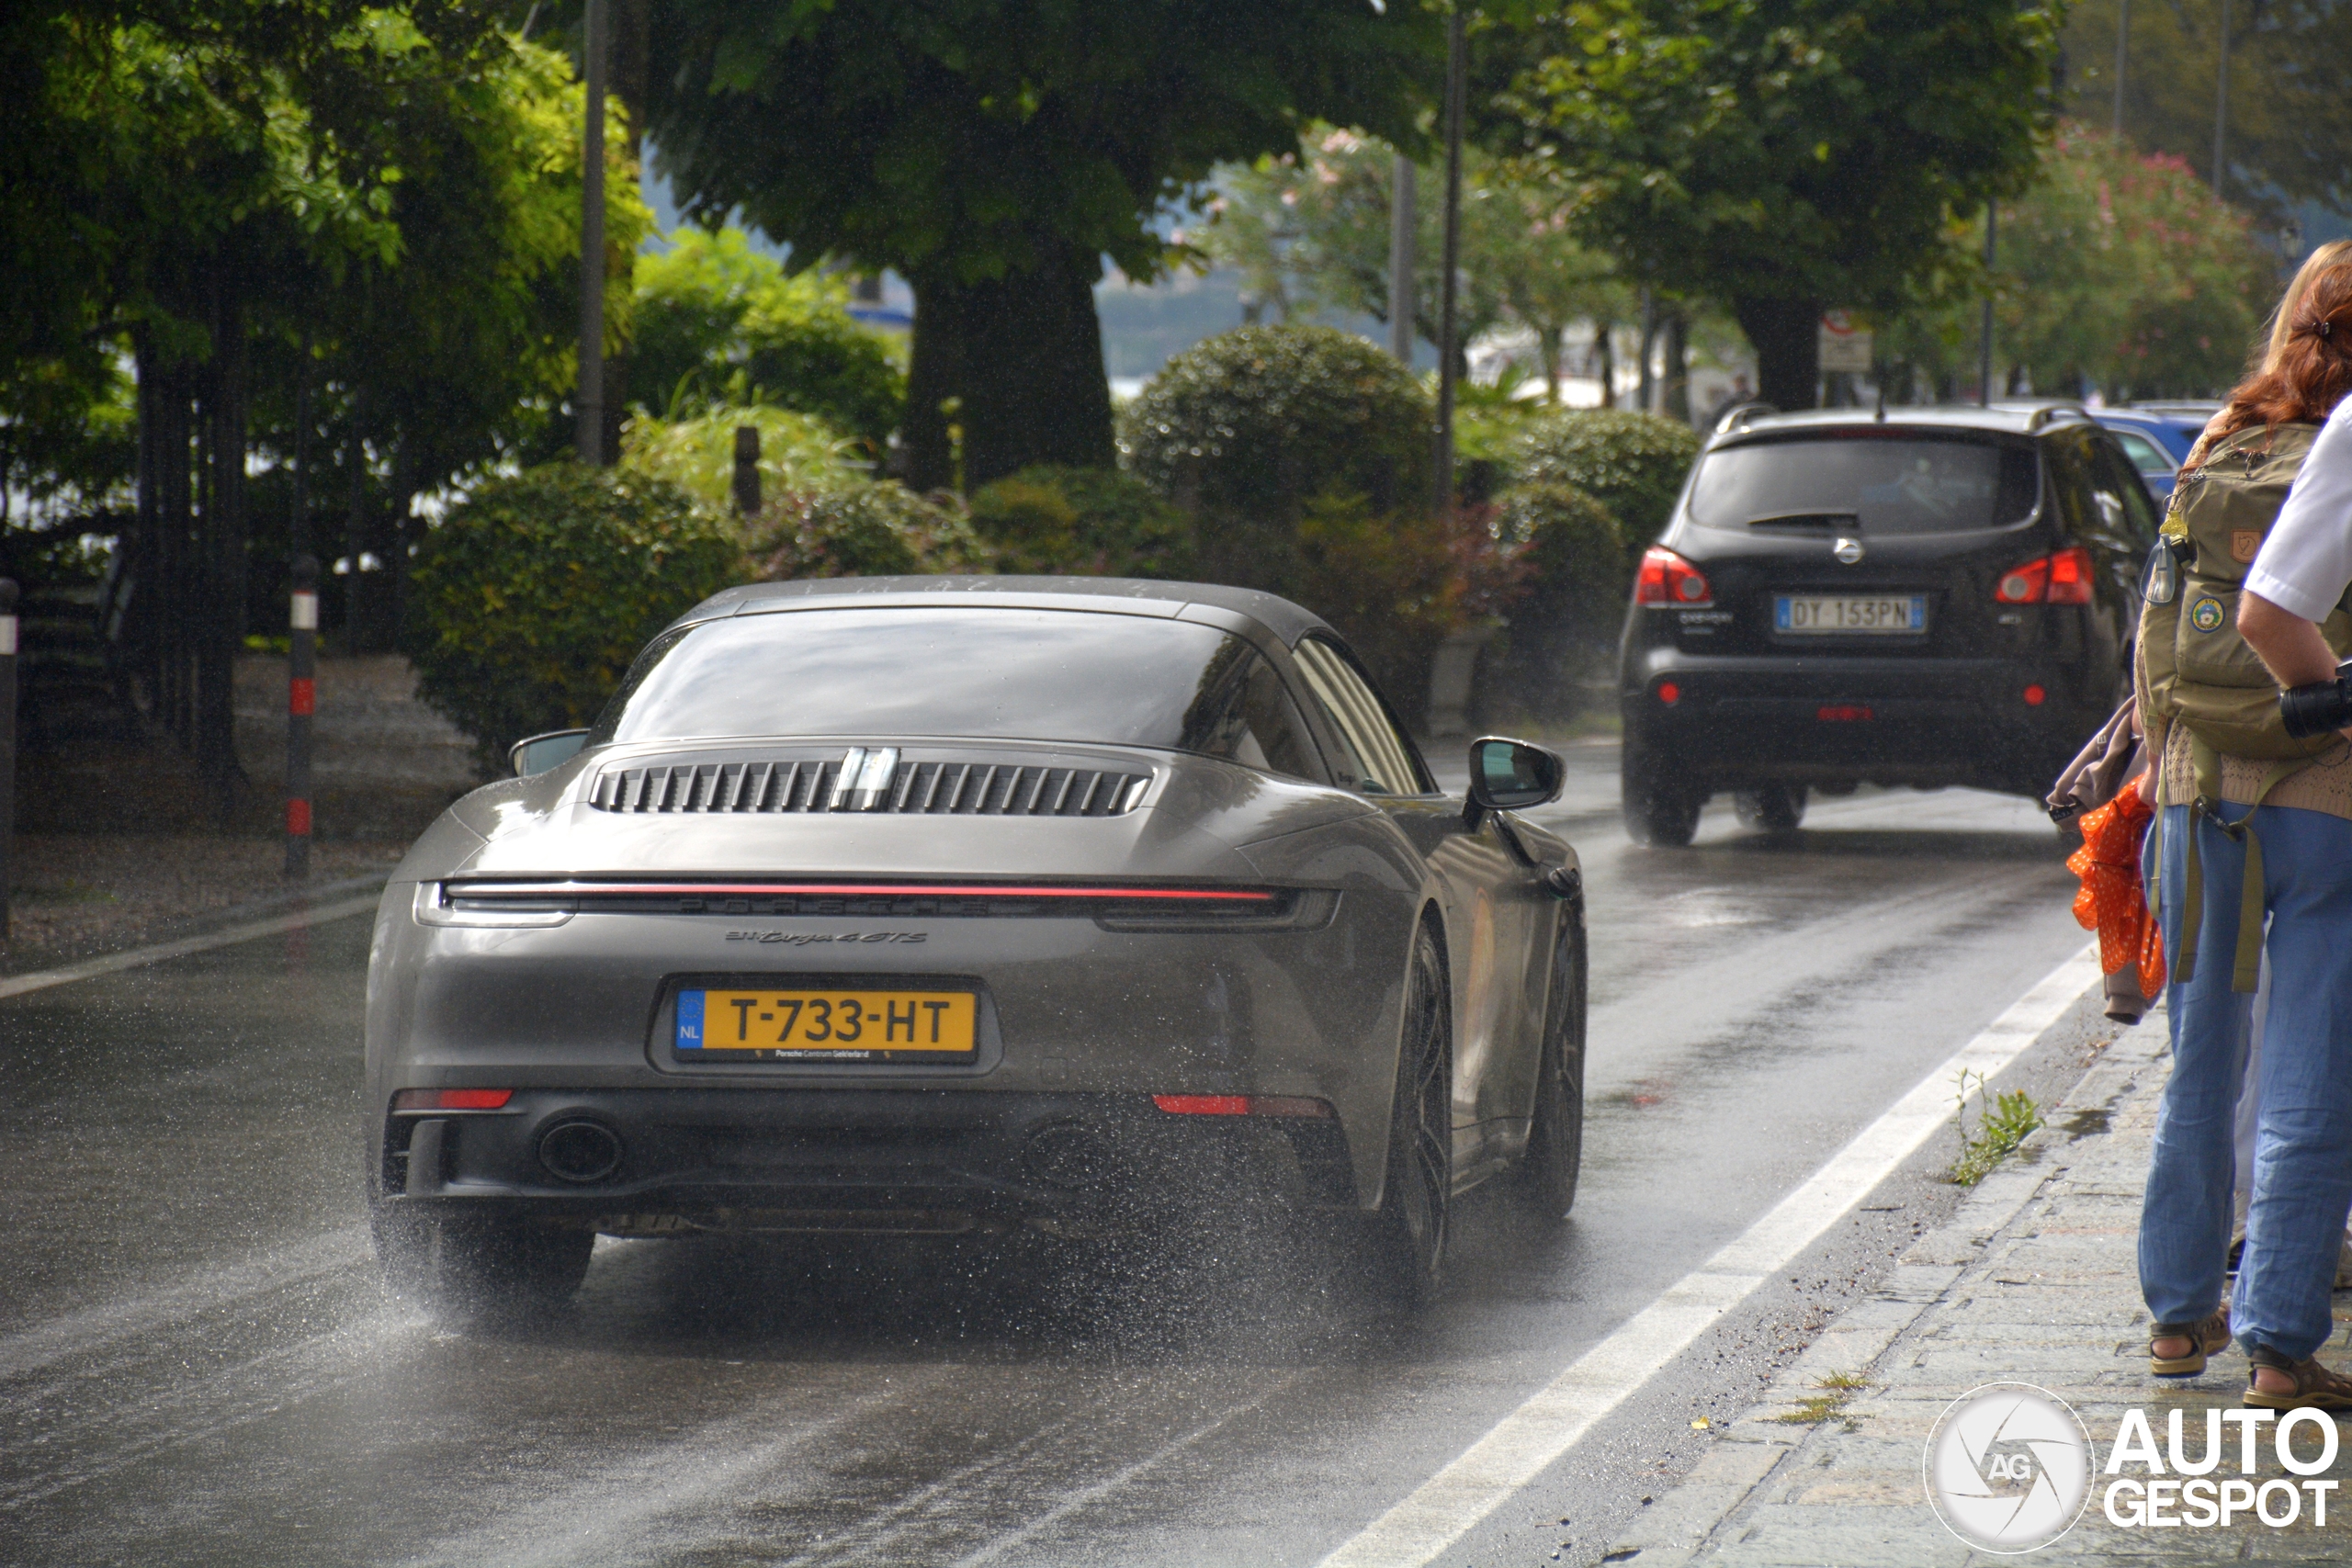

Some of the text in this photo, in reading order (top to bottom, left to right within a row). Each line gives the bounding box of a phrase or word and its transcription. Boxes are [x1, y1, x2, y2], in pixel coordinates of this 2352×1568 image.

[1793, 602, 1821, 626] DY
[1836, 602, 1907, 626] 153PN
[730, 998, 950, 1043] T-733-HT
[680, 1026, 699, 1039] NL
[775, 1049, 803, 1057] Porsche
